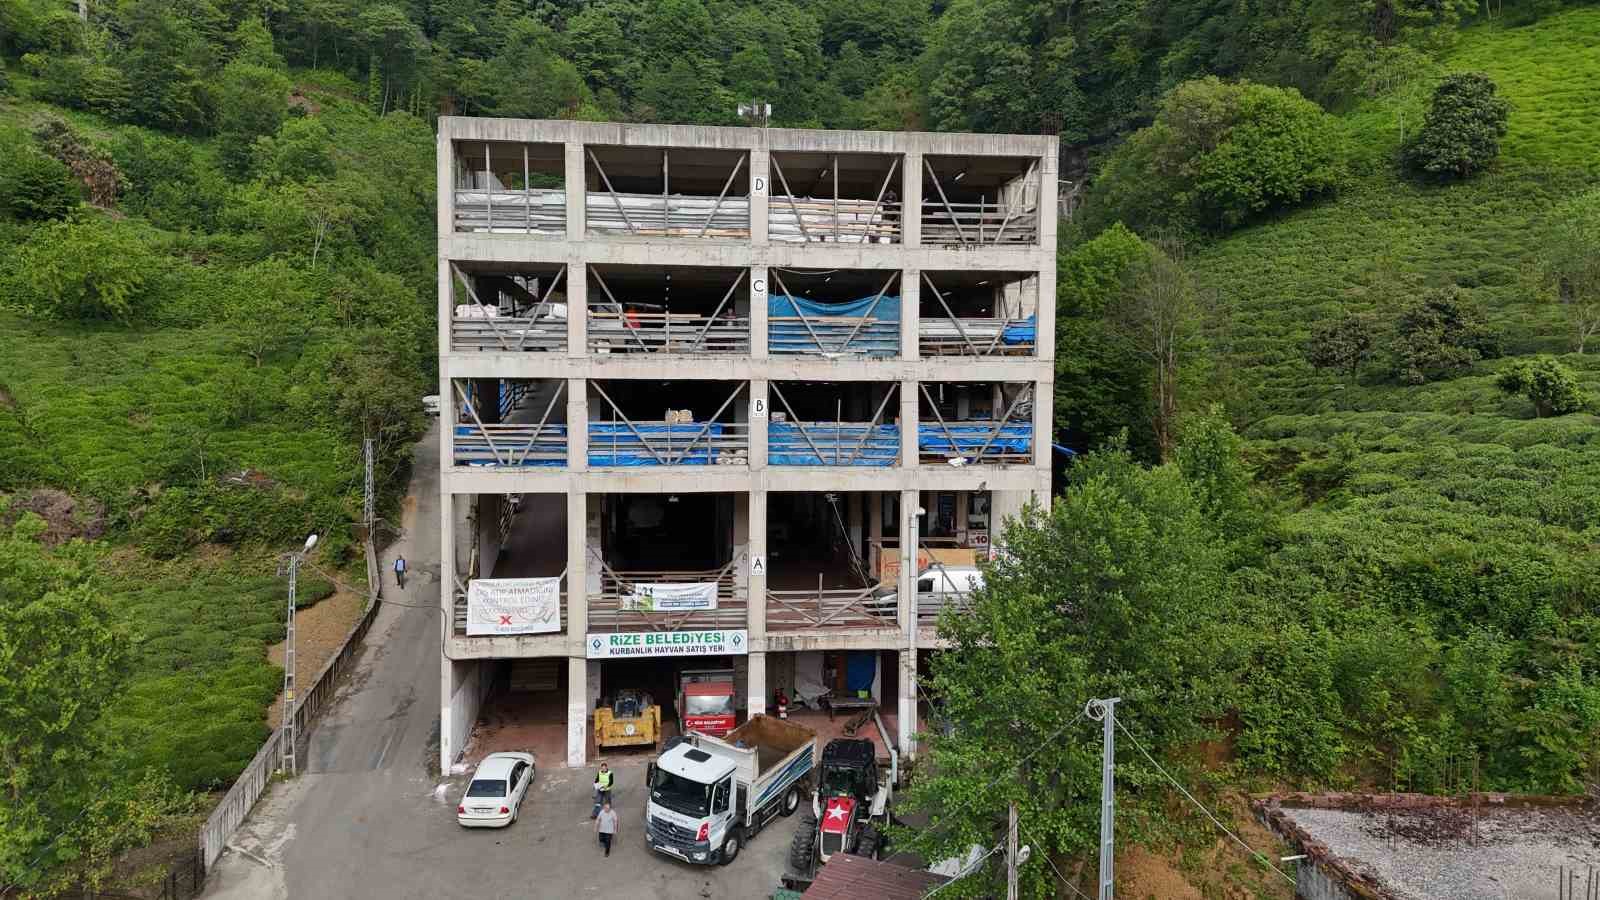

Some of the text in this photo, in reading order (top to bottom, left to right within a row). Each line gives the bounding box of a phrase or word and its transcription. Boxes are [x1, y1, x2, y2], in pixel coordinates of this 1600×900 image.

[756, 178, 764, 190] D
[753, 279, 764, 292] C
[756, 399, 764, 412] B
[753, 557, 763, 569] A
[609, 646, 653, 656] KURBANLIK
[654, 646, 684, 655] HAYVAN
[685, 645, 707, 654] SATIŞ
